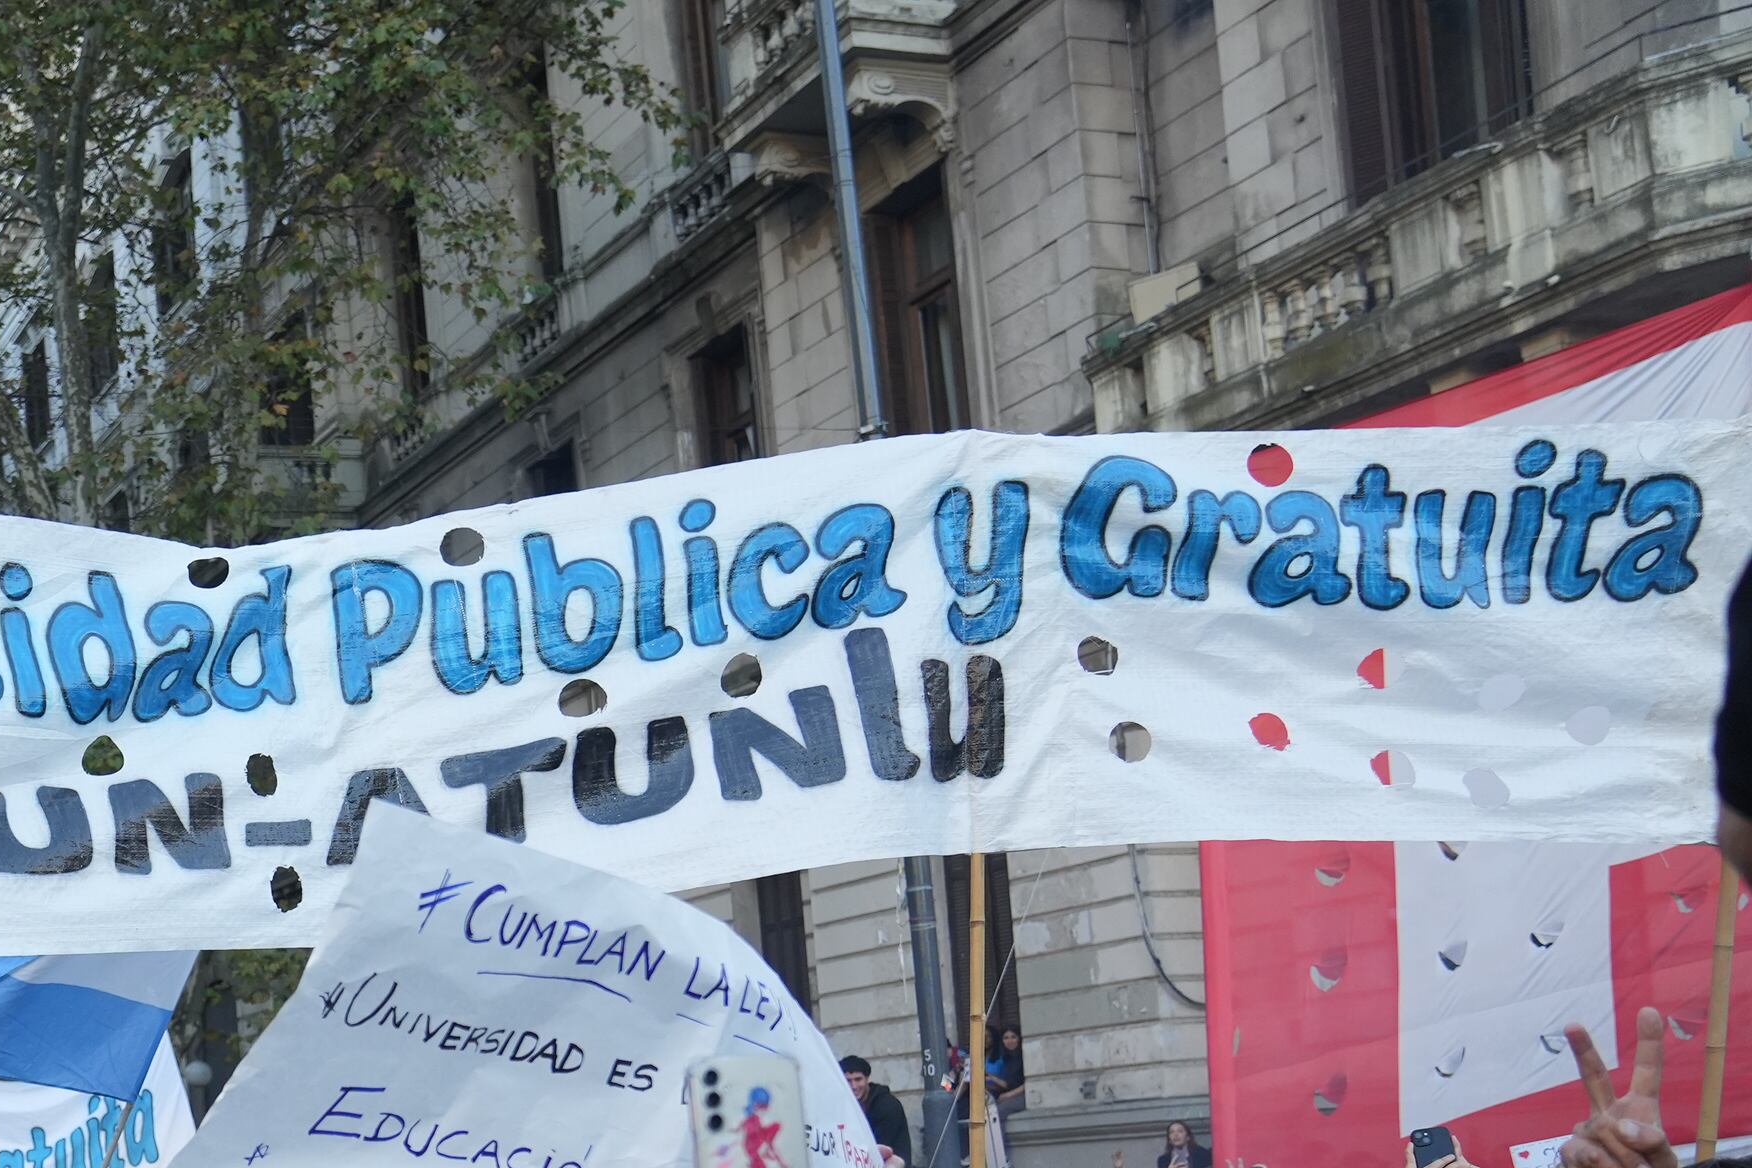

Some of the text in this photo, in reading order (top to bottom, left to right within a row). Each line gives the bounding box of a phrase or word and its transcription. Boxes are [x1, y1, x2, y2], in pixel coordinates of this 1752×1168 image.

[933, 478, 1030, 646] y
[1058, 438, 1705, 611] Gratuita
[683, 957, 731, 1007] LA
[606, 1059, 660, 1092] ES
